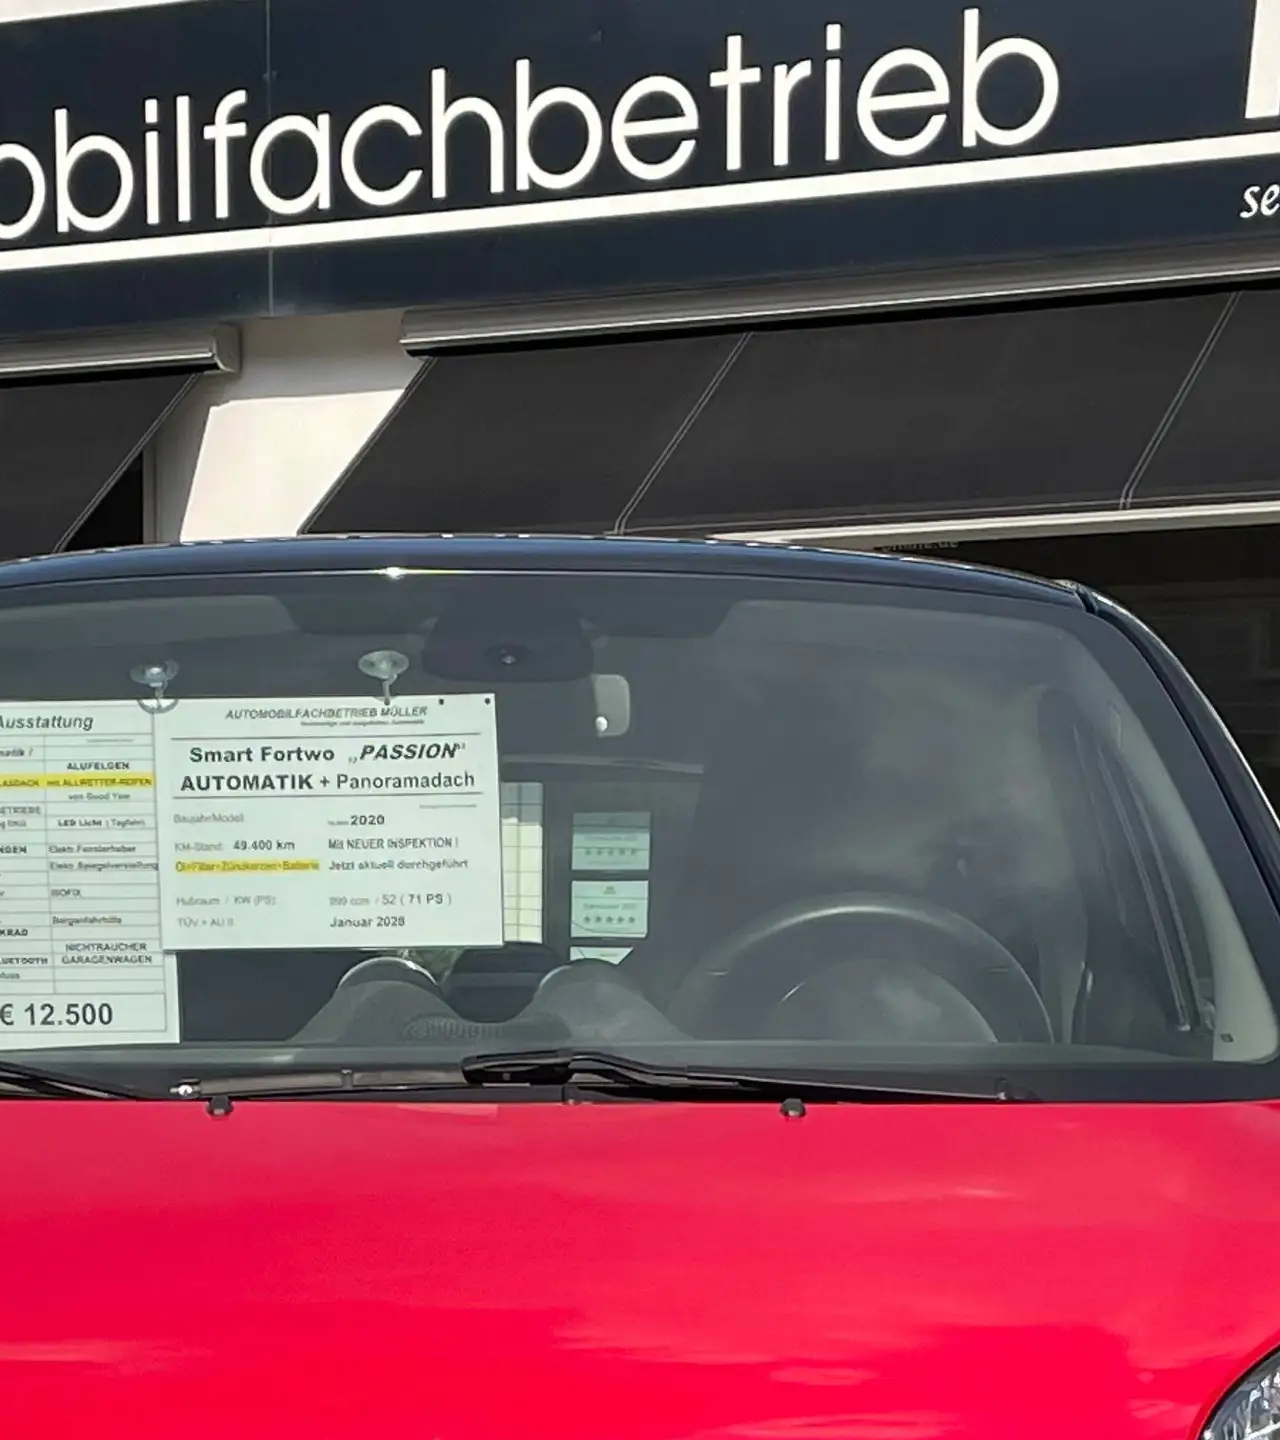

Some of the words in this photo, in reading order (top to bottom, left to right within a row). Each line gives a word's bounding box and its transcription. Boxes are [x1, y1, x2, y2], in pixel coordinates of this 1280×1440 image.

[225, 707, 377, 719] AUTOMOBILFACHBETRIEB
[380, 705, 428, 718] MÜLLER
[189, 747, 254, 764] Smart
[261, 746, 335, 763] Fortwo
[181, 774, 313, 792] AUTOMATIK
[319, 777, 330, 789] +
[336, 771, 475, 790] Panoramadach
[350, 814, 385, 826] 2020
[233, 839, 273, 851] 49.400
[276, 839, 296, 850] km
[347, 838, 385, 849] NEUER
[426, 893, 443, 905] PS
[330, 917, 373, 928] Januar
[24, 1002, 113, 1026] 12.500
